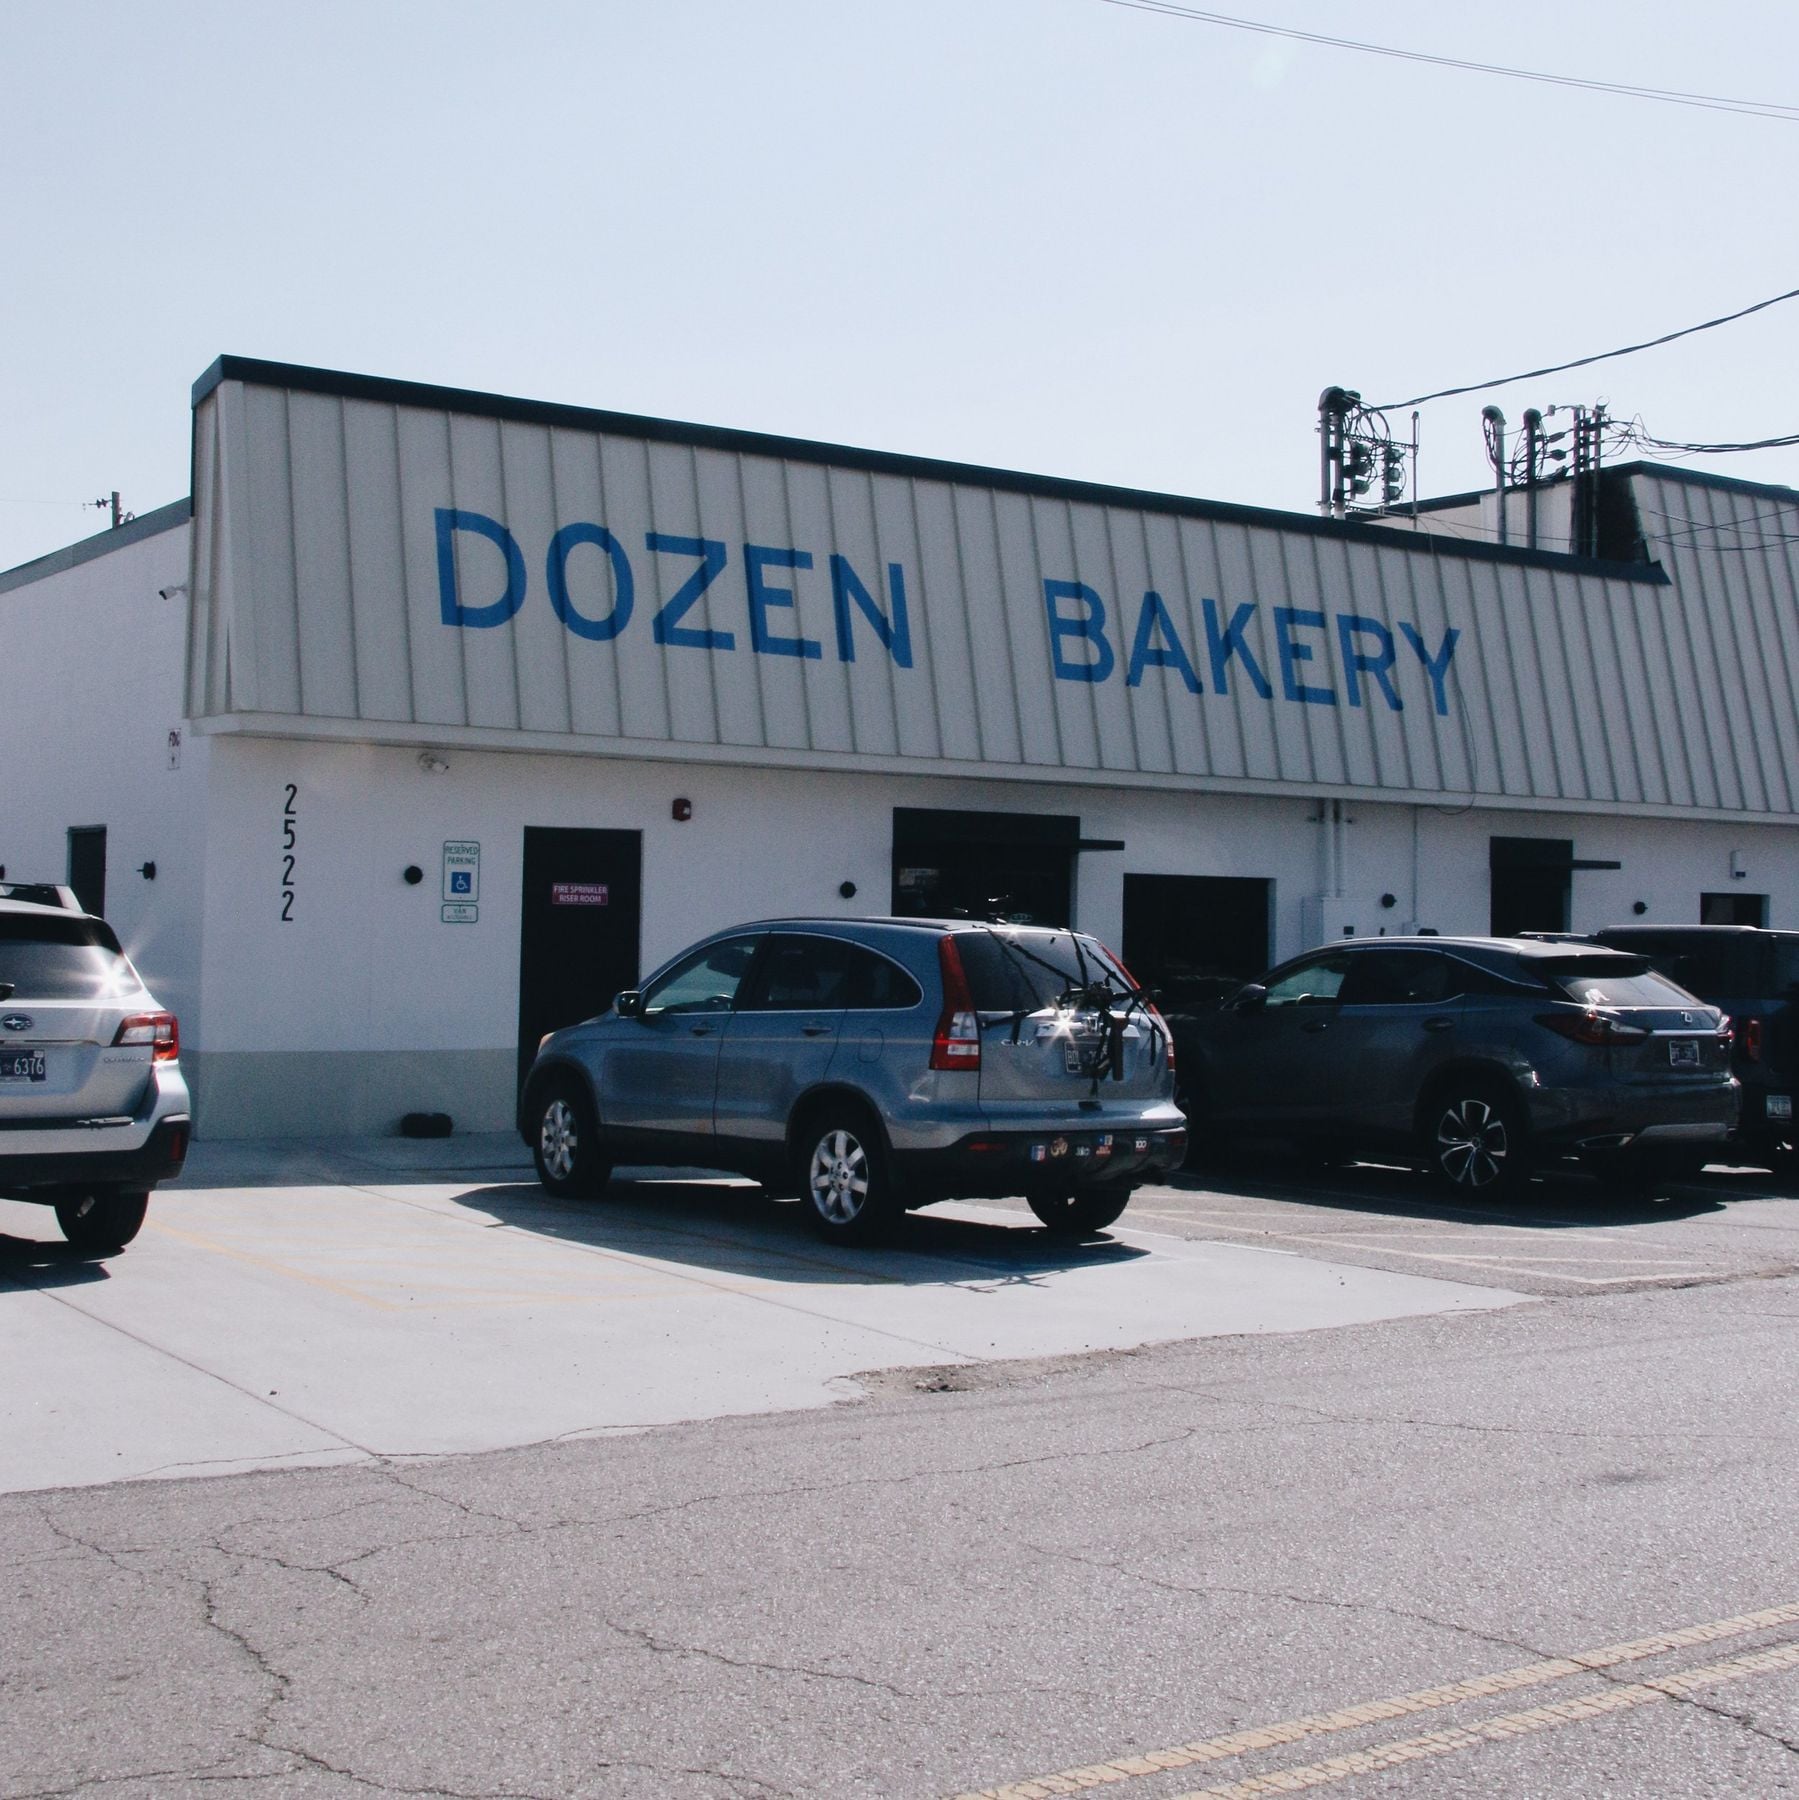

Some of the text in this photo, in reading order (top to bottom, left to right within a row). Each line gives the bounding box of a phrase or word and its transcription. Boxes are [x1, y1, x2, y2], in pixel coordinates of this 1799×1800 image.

[434, 507, 1461, 717] DOZEN BAKERY
[281, 784, 298, 921] 2522
[445, 846, 478, 855] RESERVED
[447, 857, 476, 865] PARKING
[553, 885, 608, 894] FIRE SPRINKLER
[559, 894, 578, 902] RISER
[14, 1058, 44, 1075] 6376
